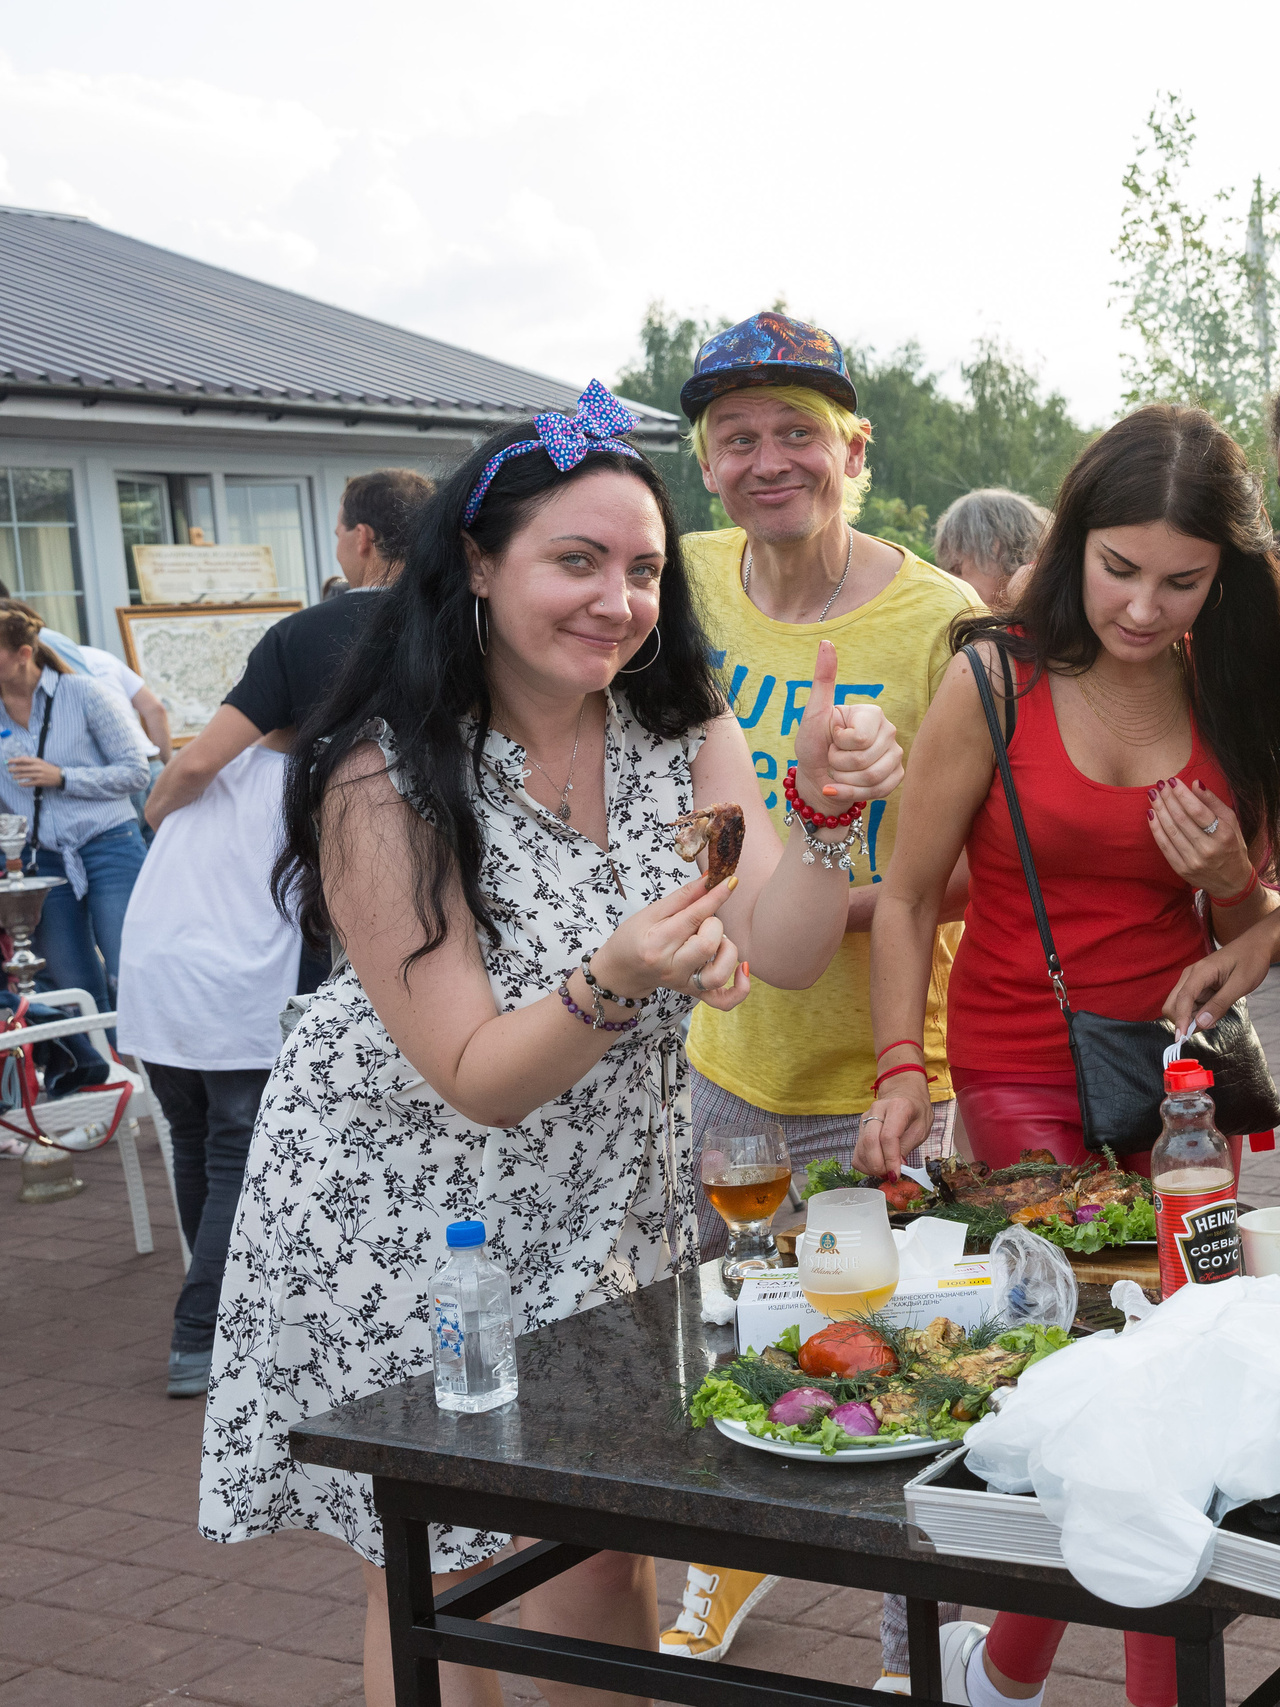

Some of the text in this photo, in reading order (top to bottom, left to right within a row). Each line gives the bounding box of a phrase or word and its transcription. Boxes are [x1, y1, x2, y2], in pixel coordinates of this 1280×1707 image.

[1195, 1209, 1236, 1233] HEINZ
[1198, 1248, 1239, 1269] СОУС
[767, 1303, 799, 1311] ИЗДЕЛИЯ
